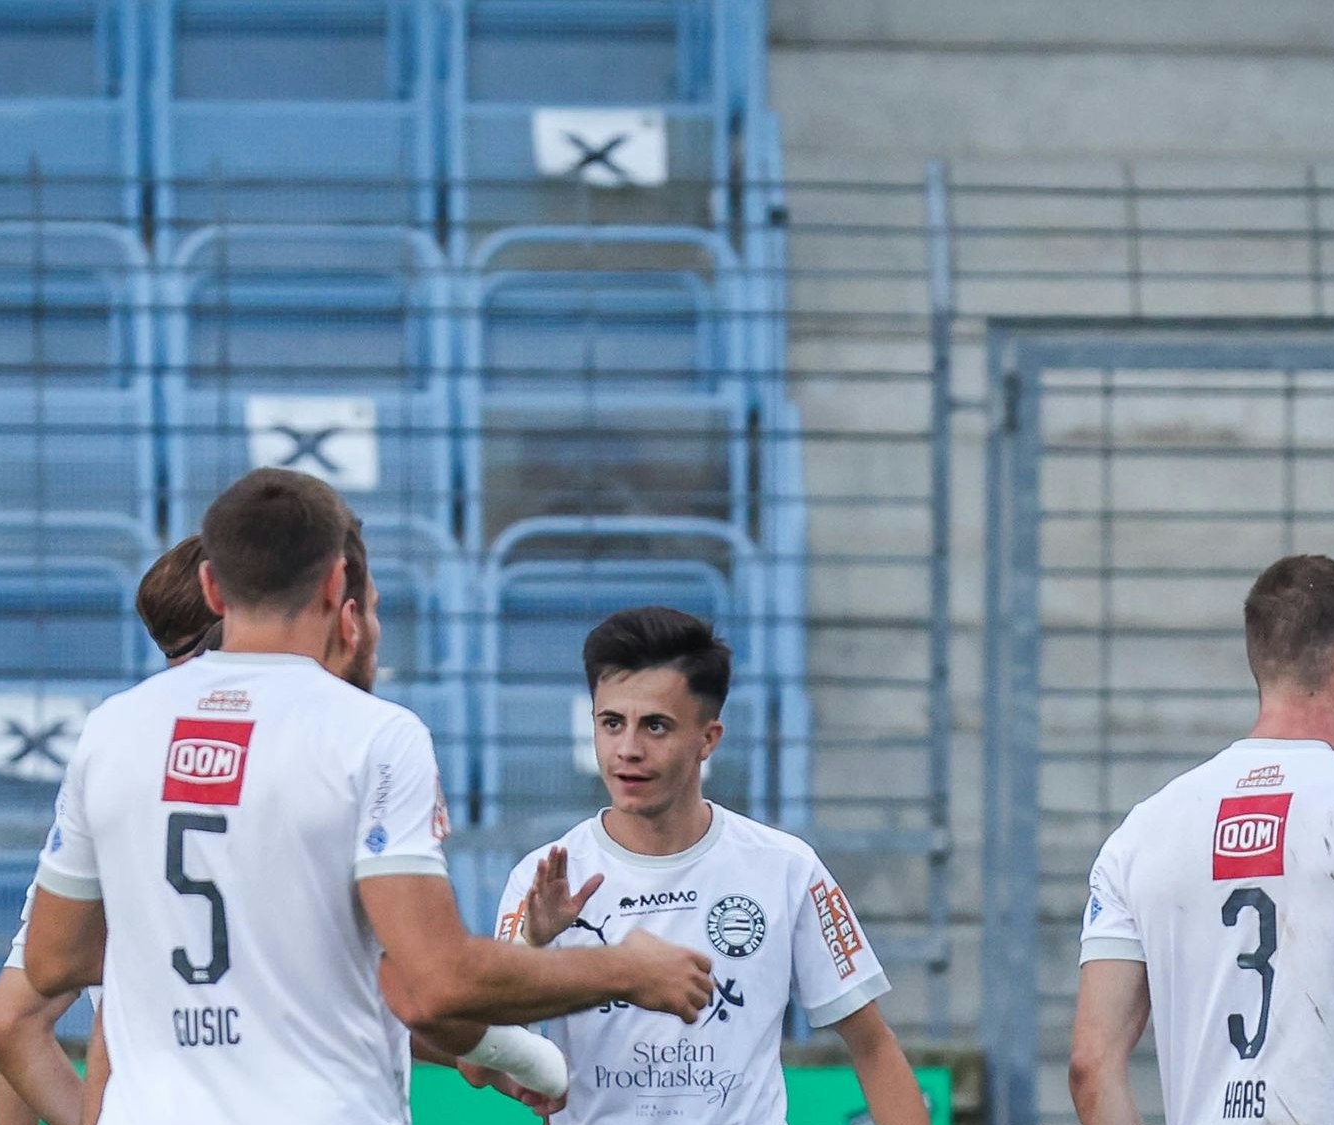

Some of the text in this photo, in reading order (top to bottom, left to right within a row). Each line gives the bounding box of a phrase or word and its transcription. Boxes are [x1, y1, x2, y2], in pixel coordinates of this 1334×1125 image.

[175, 745, 235, 776] DOM
[1223, 820, 1273, 849] DOM
[164, 812, 231, 985] 5
[640, 890, 698, 907] MOMO
[814, 886, 852, 977] ENERGIE
[831, 893, 858, 951] WIEN
[1222, 887, 1277, 1059] 3
[633, 1038, 714, 1065] Stefan
[595, 1063, 714, 1088] Prochaska
[1223, 1080, 1267, 1119] HAAS
